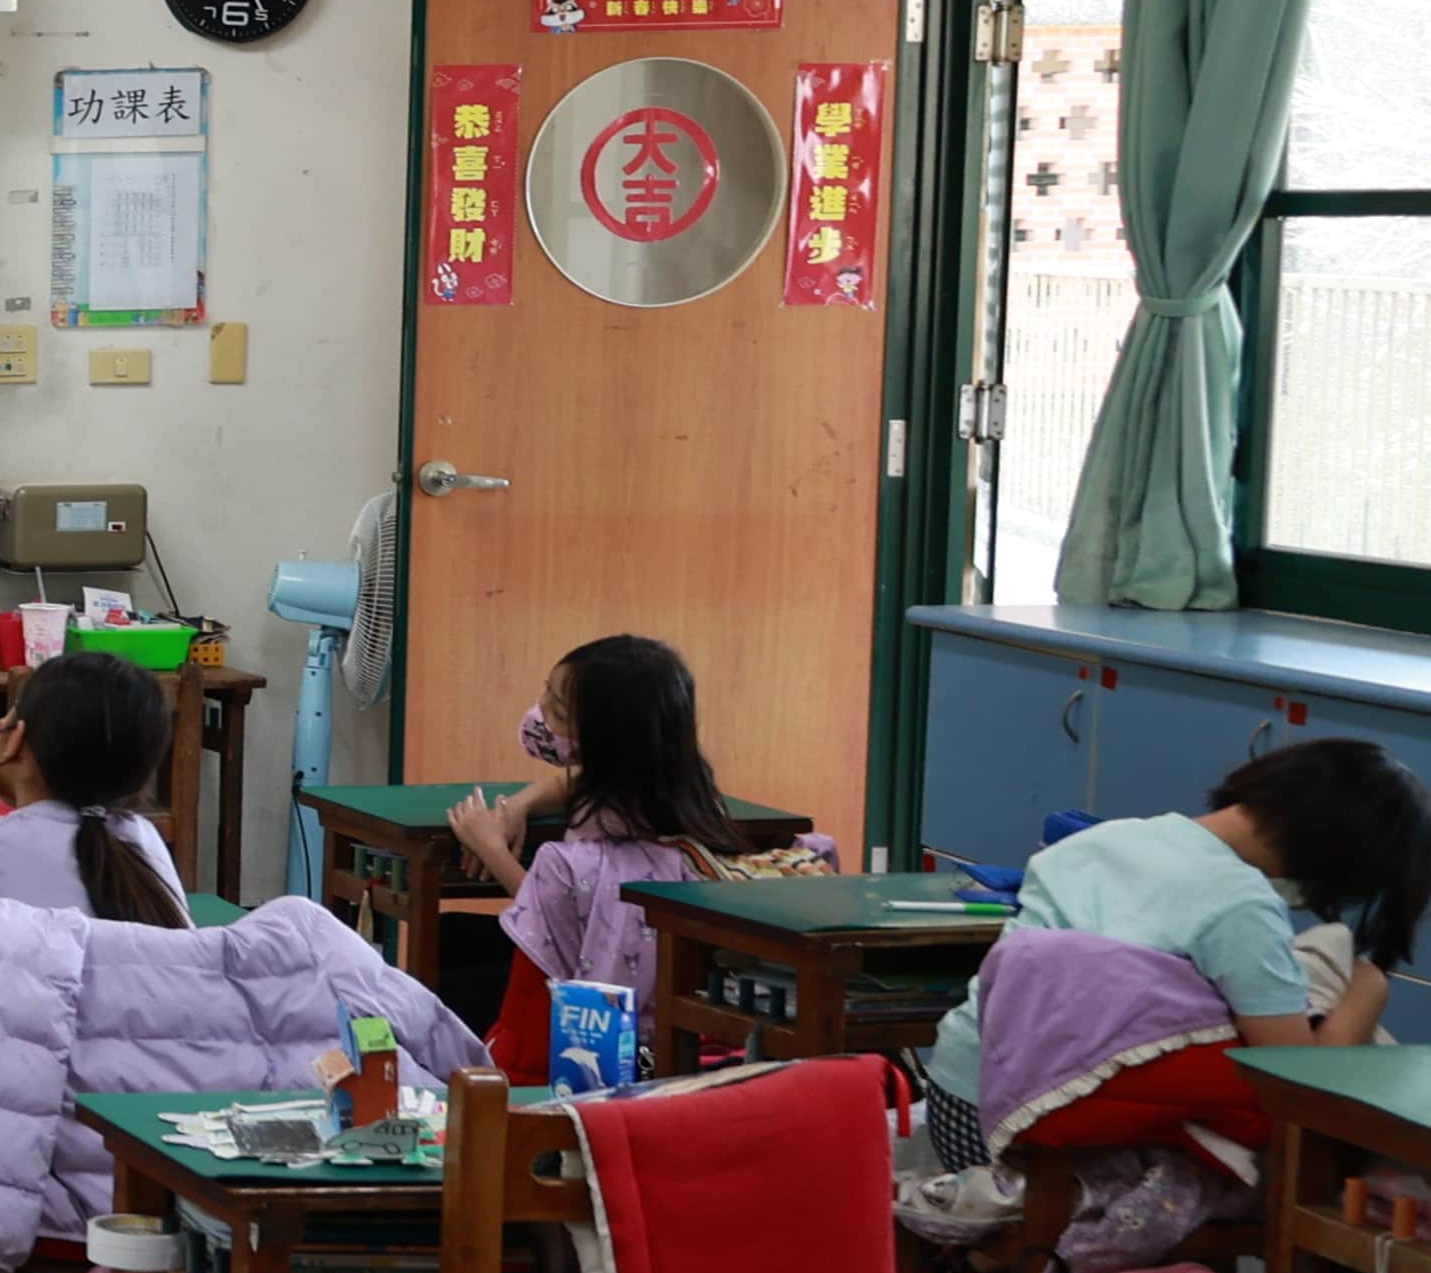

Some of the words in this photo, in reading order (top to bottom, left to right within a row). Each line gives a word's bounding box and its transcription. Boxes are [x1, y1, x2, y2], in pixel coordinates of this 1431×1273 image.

[202, 5, 218, 19] 7
[221, 1, 251, 26] 6
[67, 84, 191, 127] 功課表
[447, 104, 491, 264] 恭喜發財
[620, 121, 679, 233] 大吉
[807, 102, 853, 265] 學業進步
[558, 1003, 612, 1034] FIN
